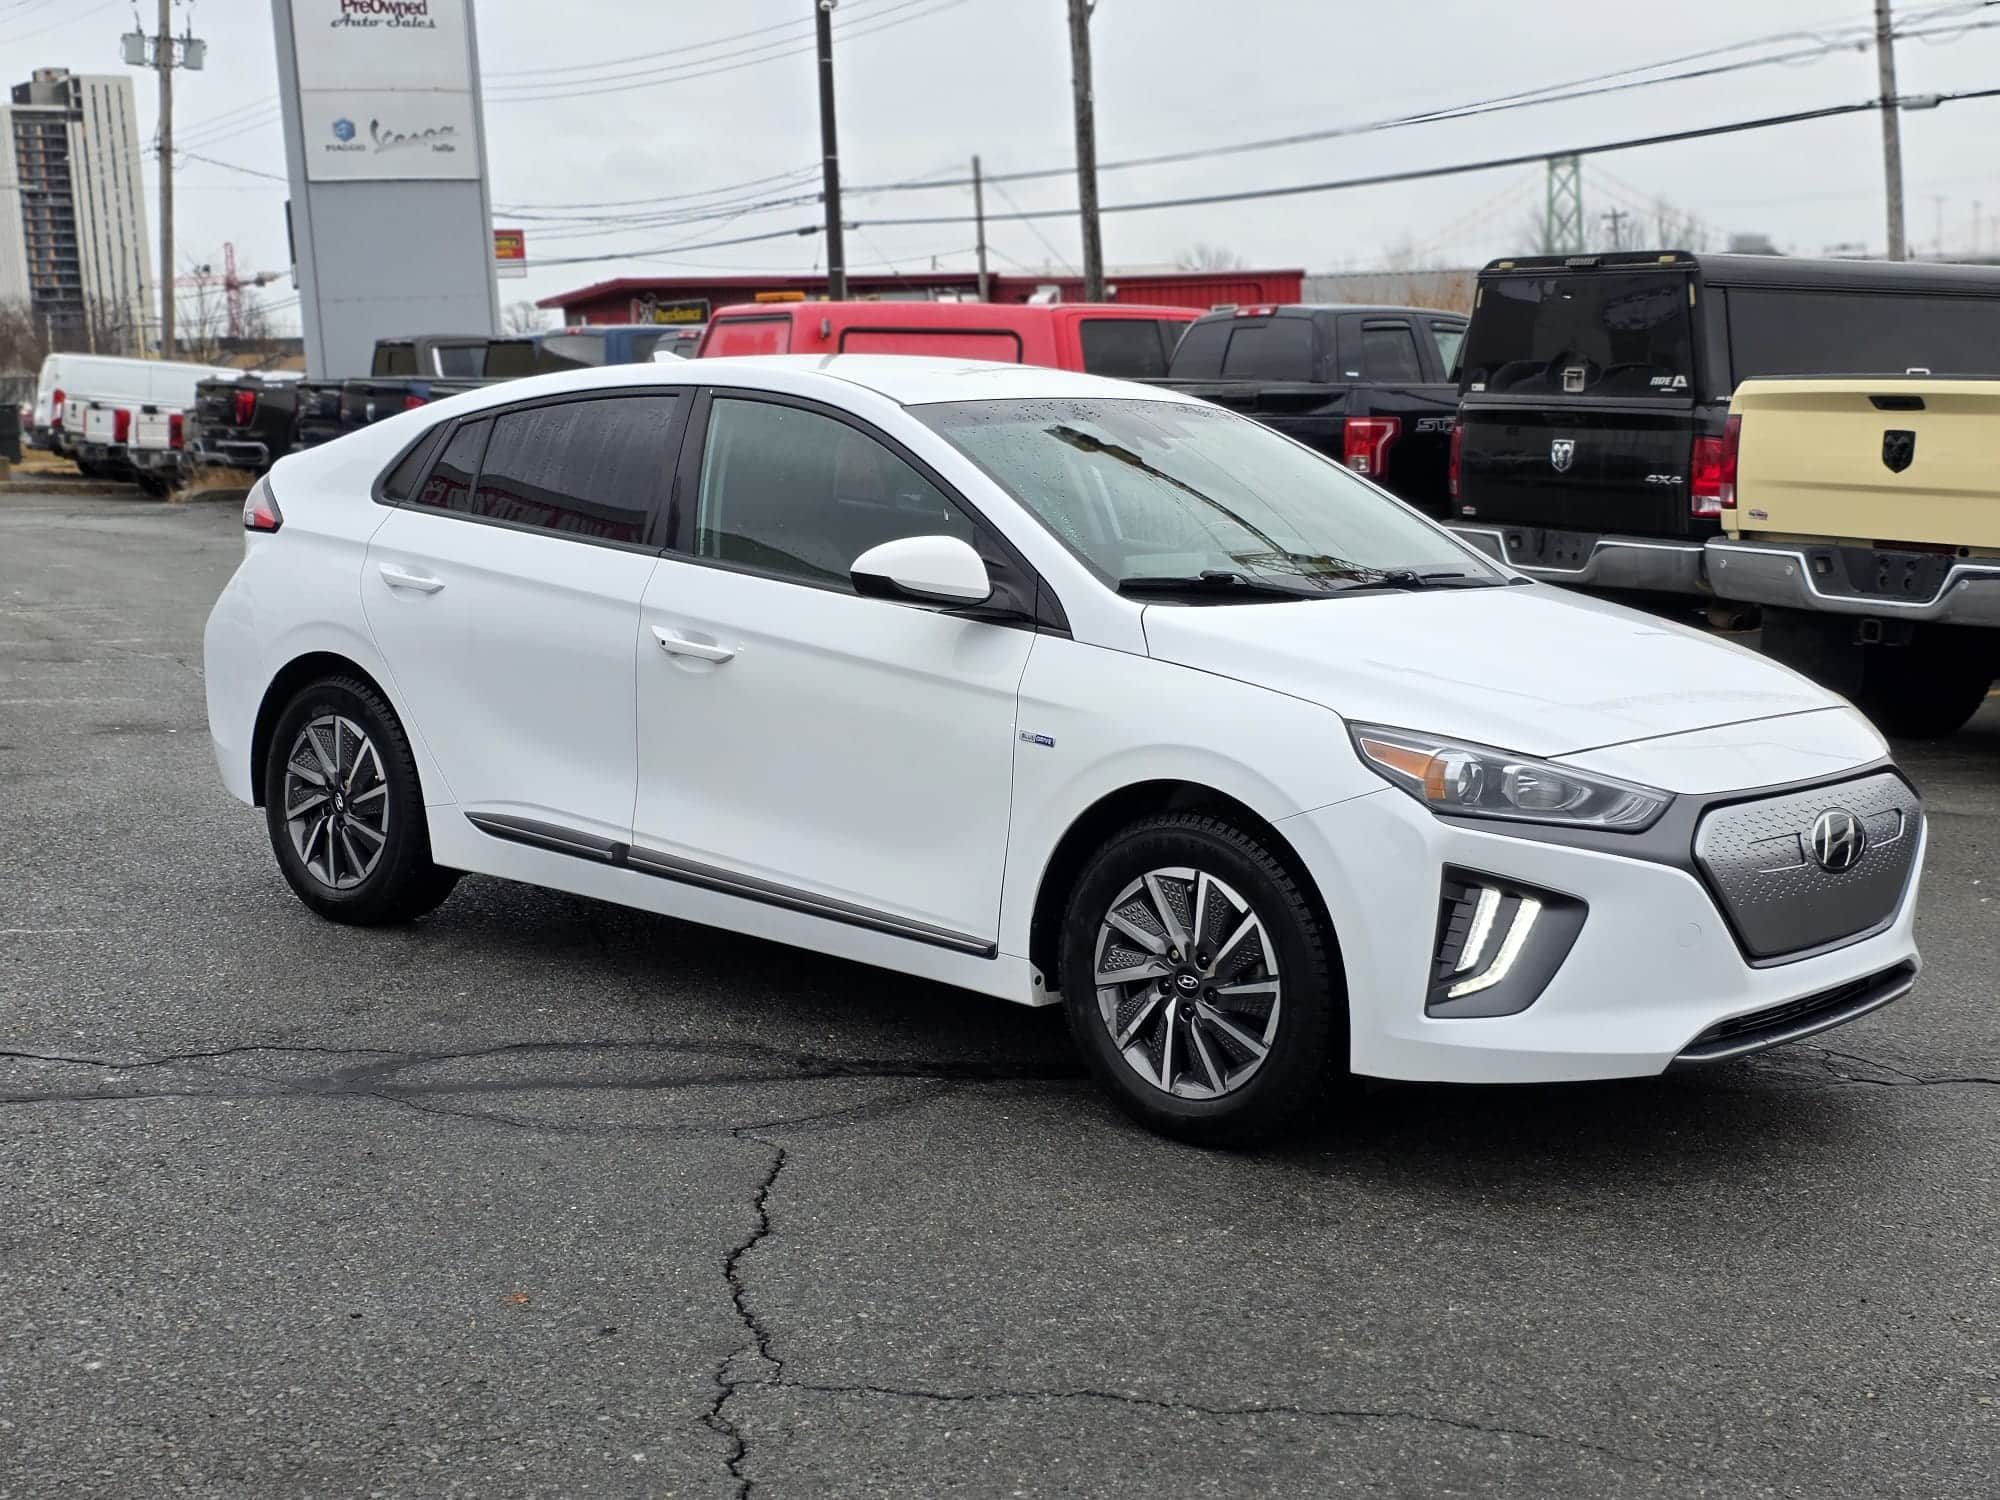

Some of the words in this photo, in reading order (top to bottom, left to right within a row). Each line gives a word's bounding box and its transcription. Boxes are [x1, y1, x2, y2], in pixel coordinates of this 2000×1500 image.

[341, 0, 428, 17] PreOwned
[330, 13, 382, 28] Auto
[386, 14, 437, 29] Sales
